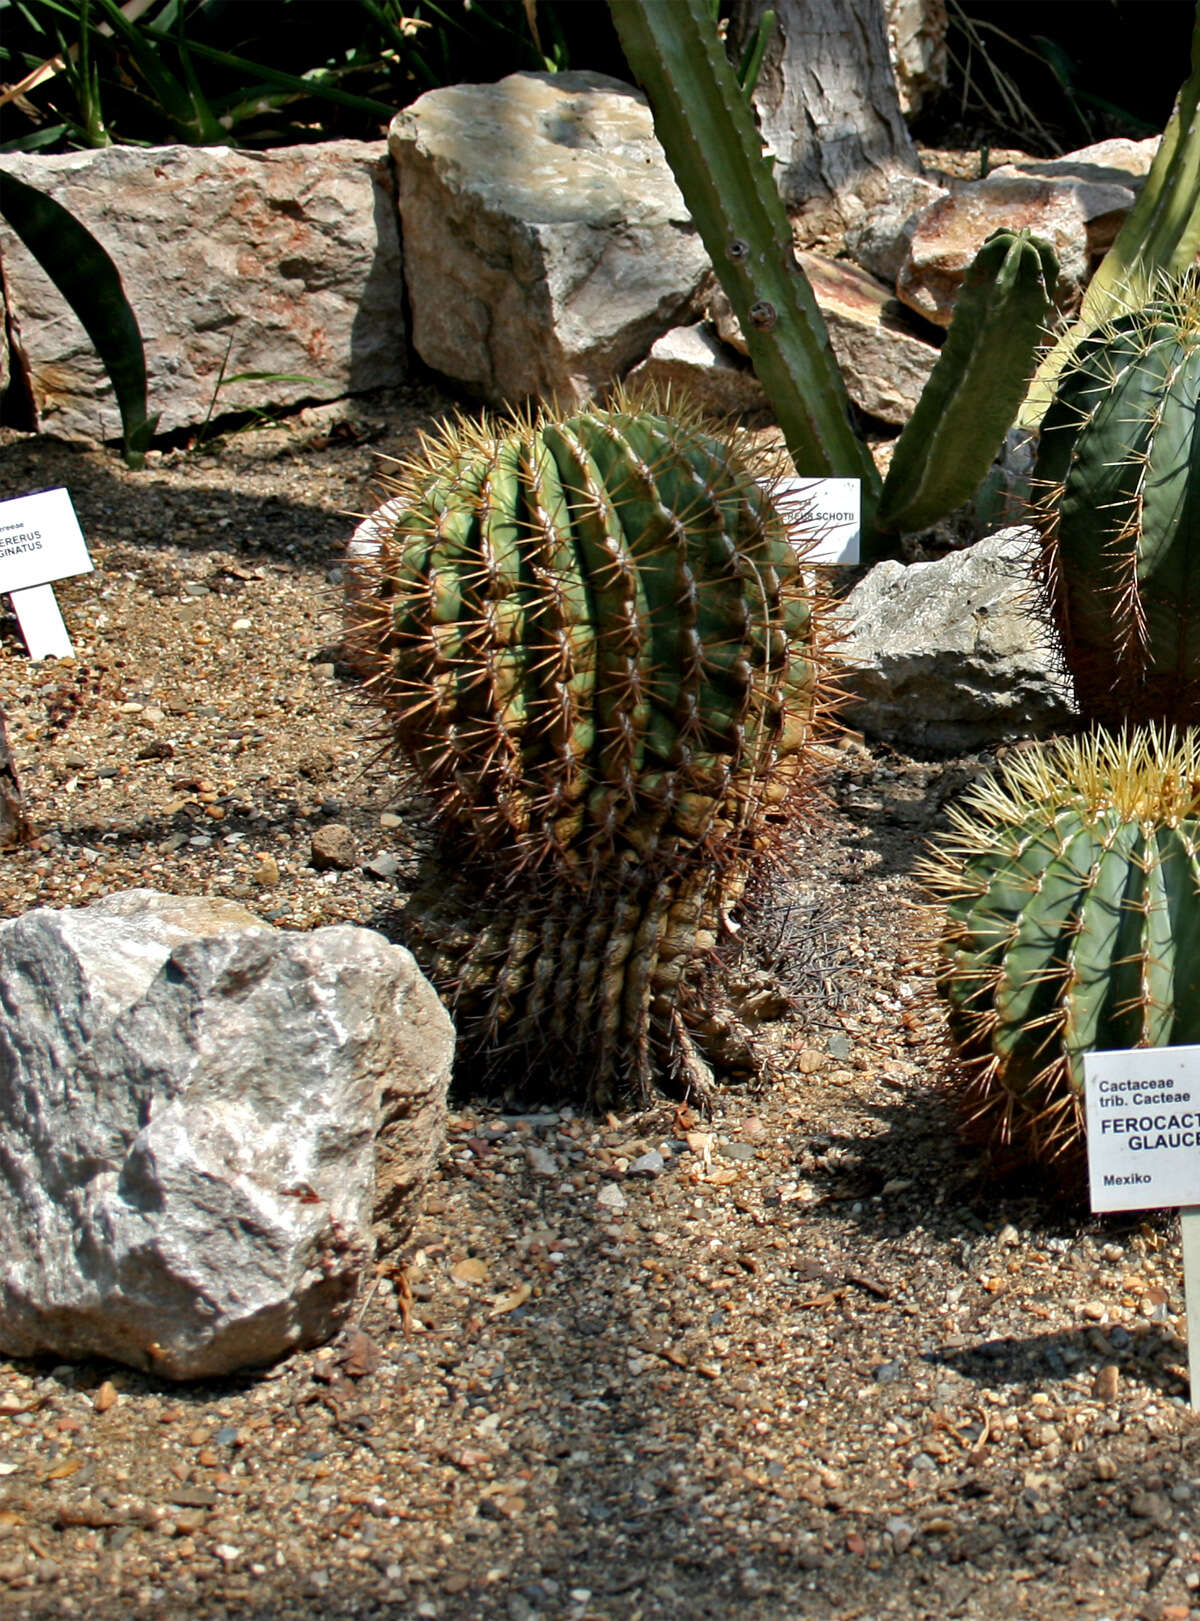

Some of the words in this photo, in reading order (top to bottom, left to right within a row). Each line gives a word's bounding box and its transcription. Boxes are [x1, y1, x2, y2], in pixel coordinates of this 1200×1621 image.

[1099, 1078, 1174, 1093] Cactaceae
[1100, 1095, 1128, 1107] trib.
[1133, 1092, 1191, 1105] Cacteae
[1103, 1173, 1152, 1187] Mexiko
